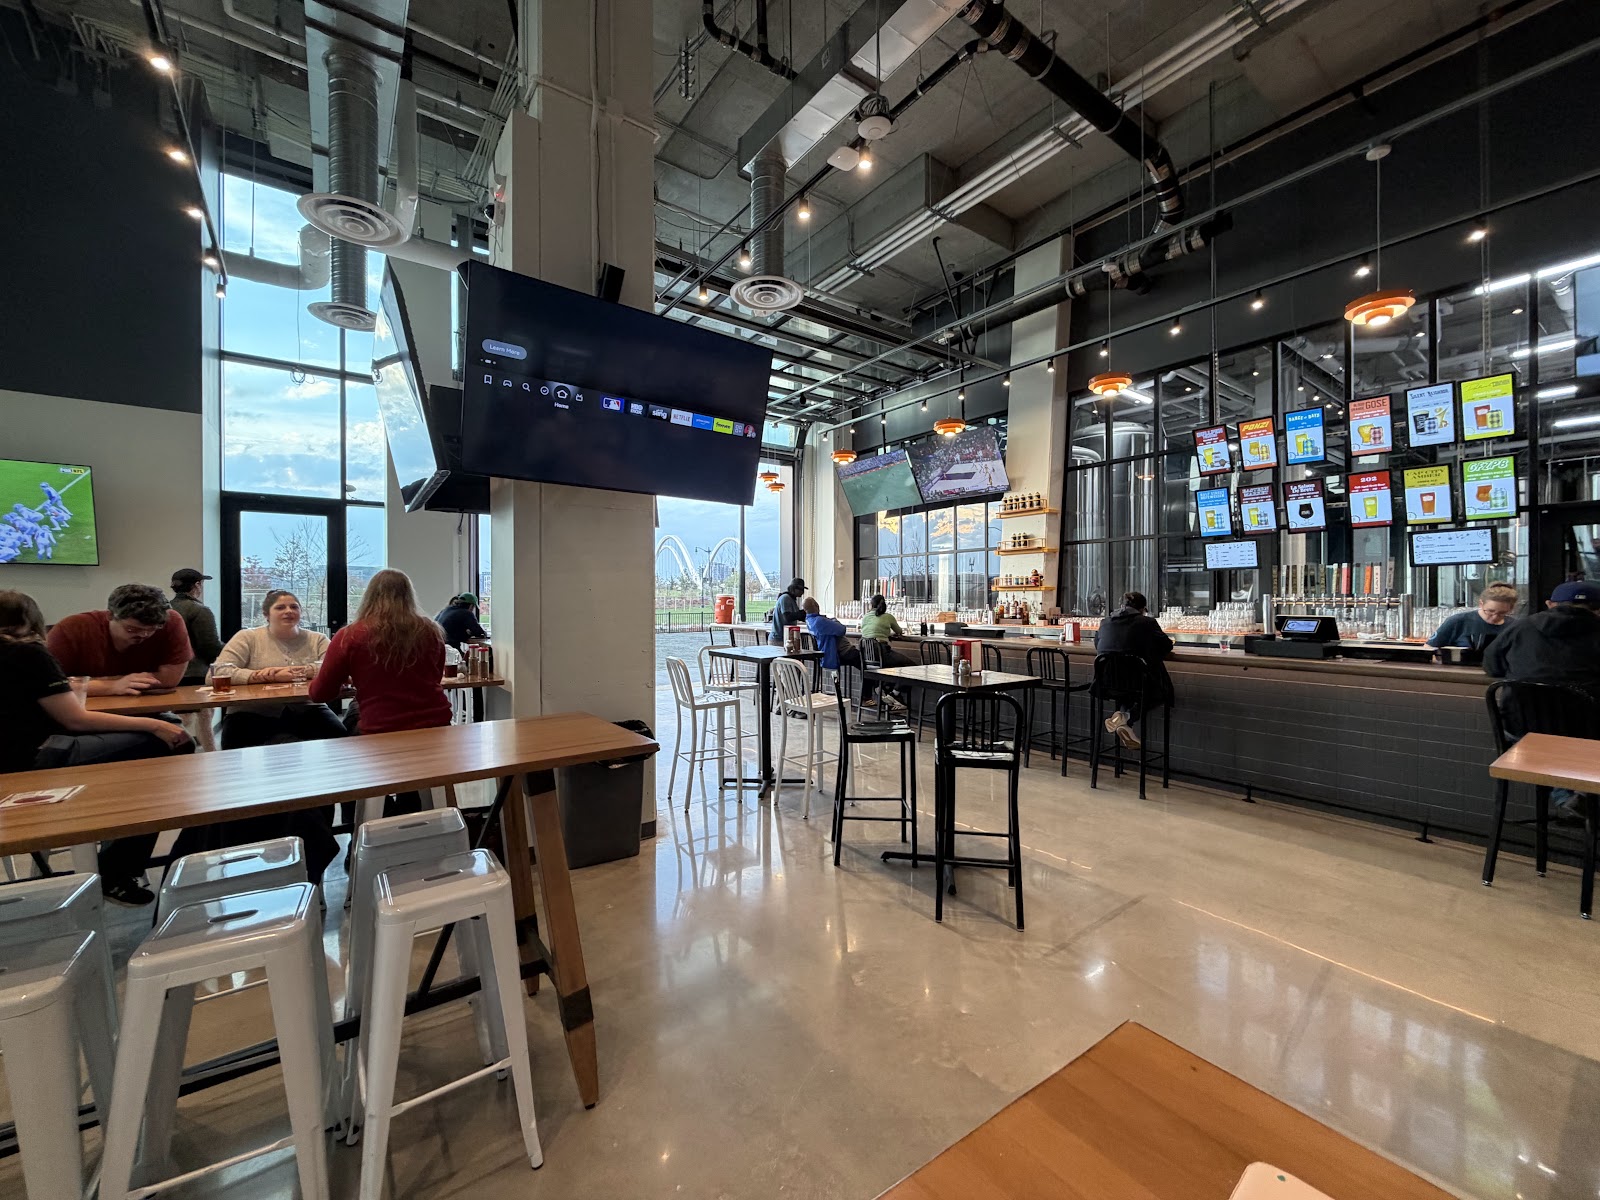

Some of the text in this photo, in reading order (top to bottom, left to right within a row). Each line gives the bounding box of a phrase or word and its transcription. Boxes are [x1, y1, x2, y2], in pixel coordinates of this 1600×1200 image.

[489, 343, 521, 356] Learn More
[1365, 398, 1388, 409] GOSE
[673, 413, 691, 423] NETFLIX
[1242, 421, 1270, 432] PONZI
[1360, 475, 1378, 483] 202
